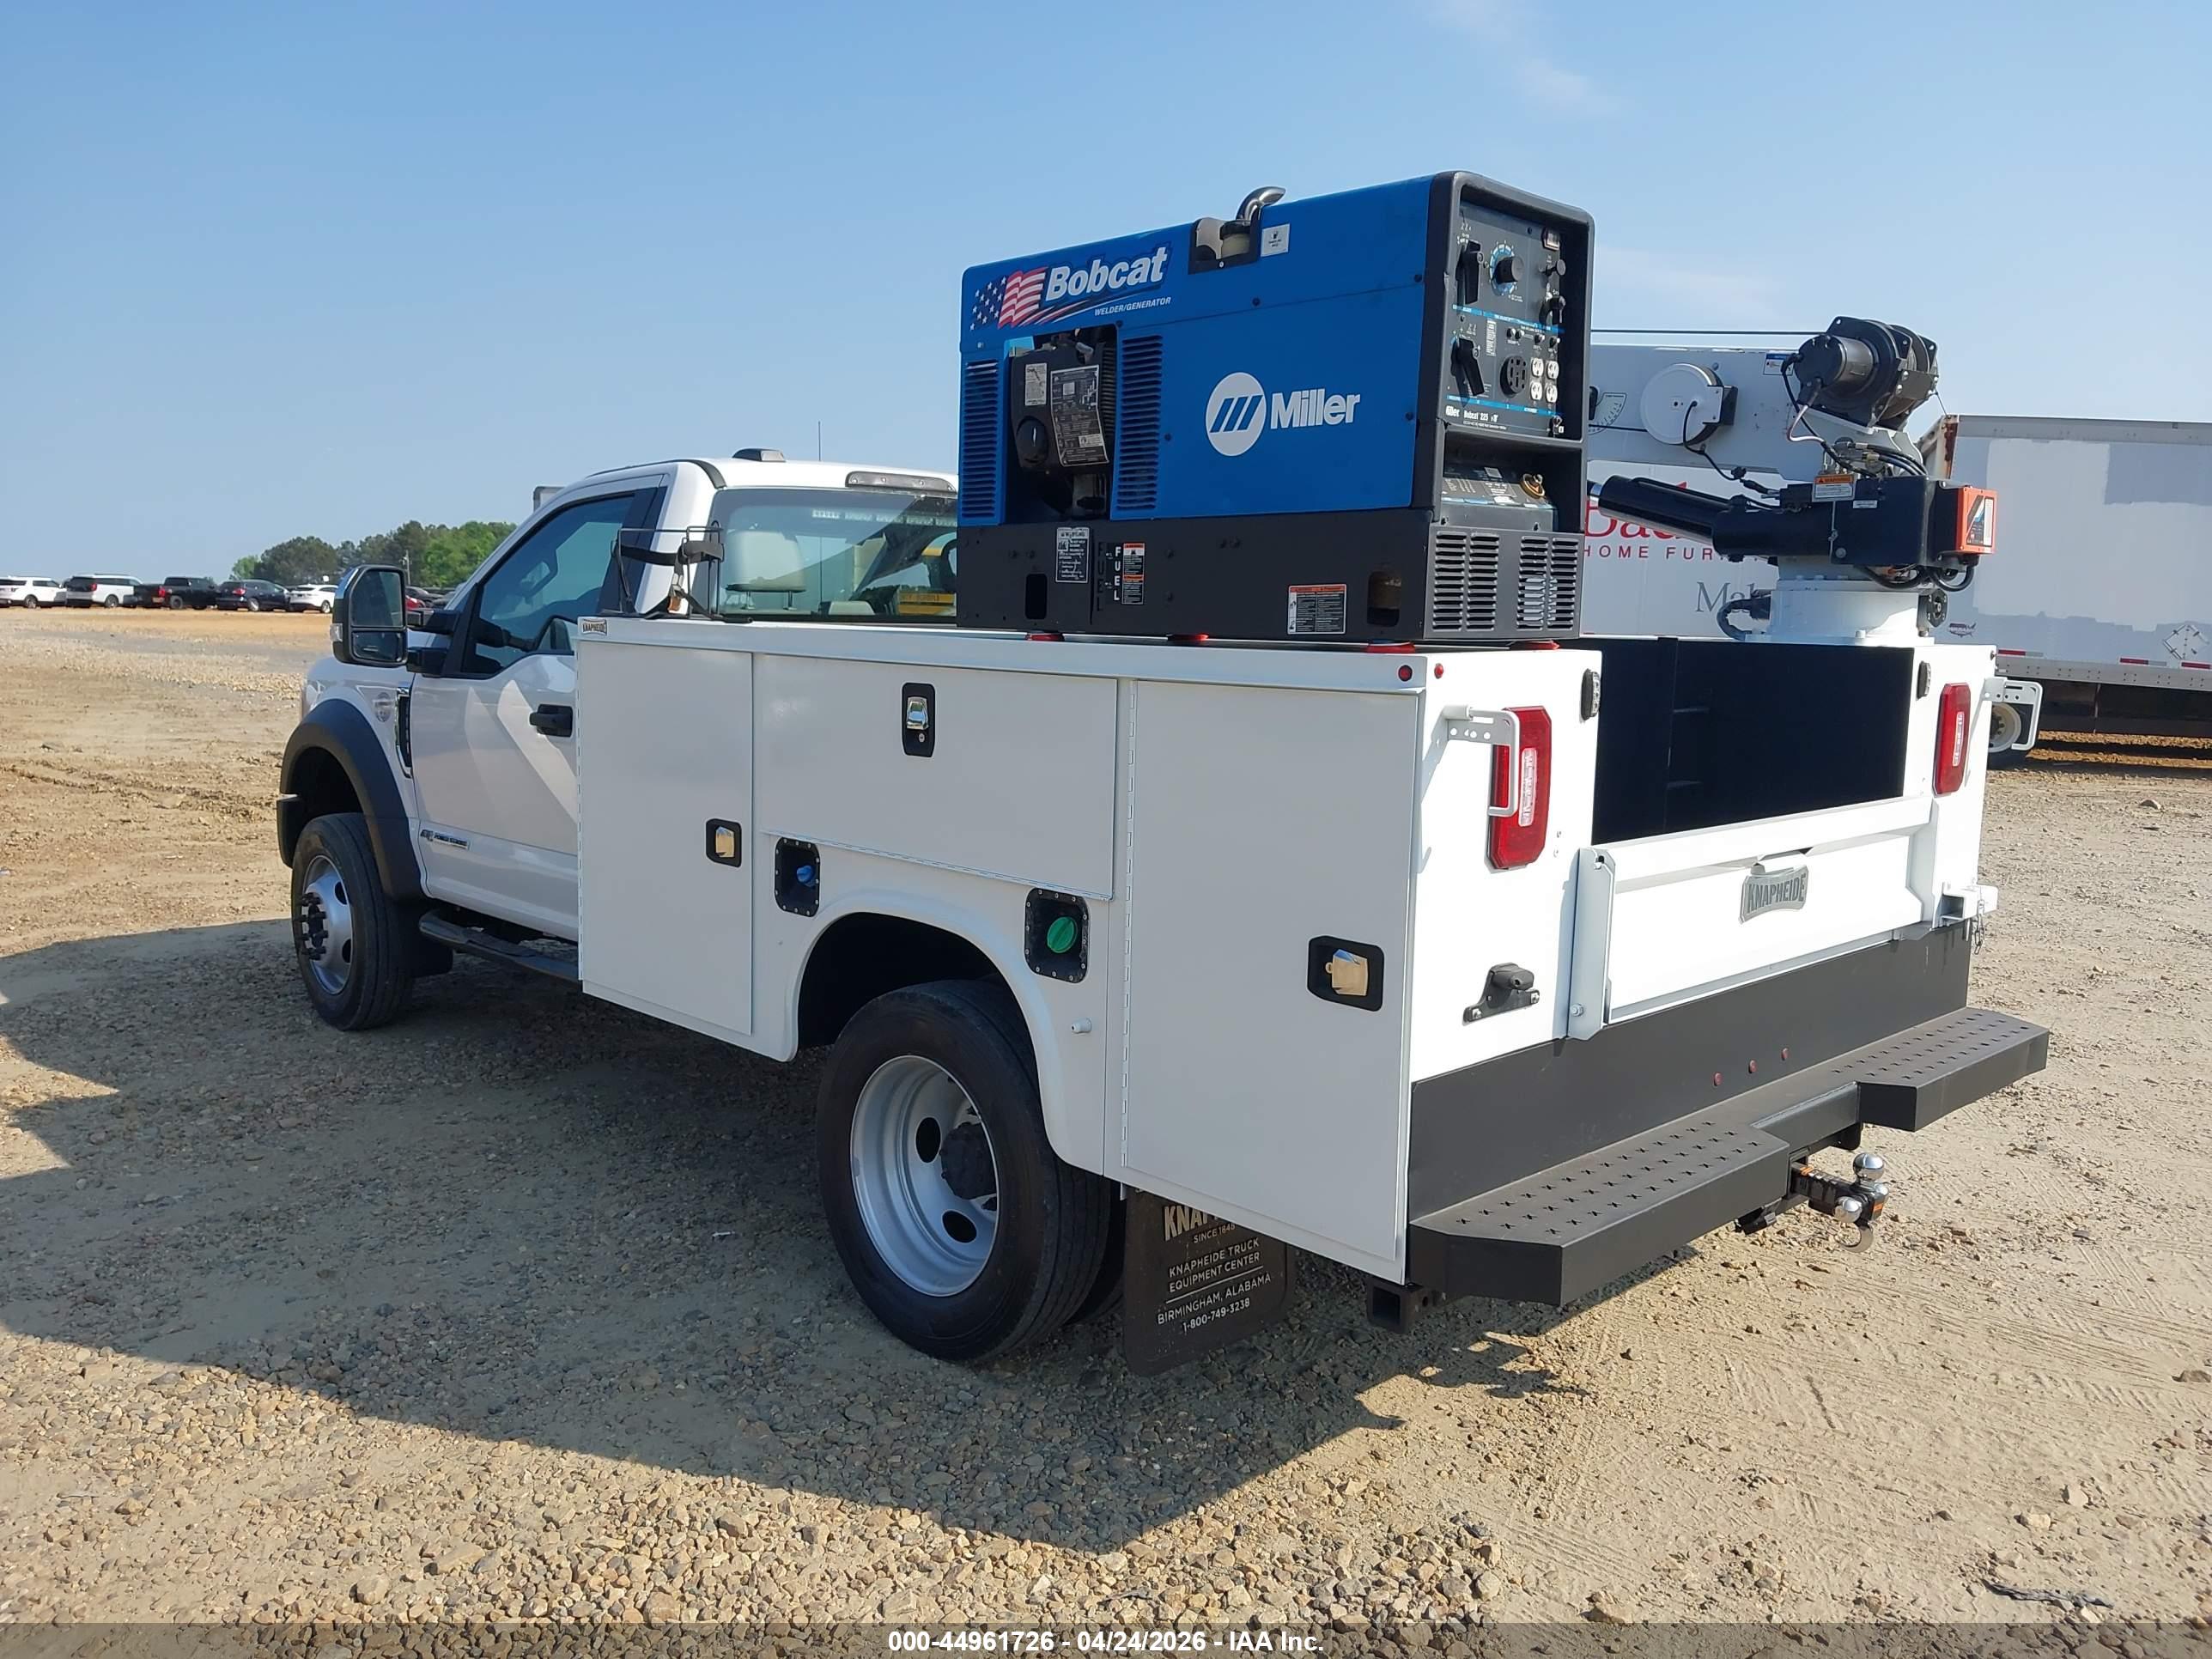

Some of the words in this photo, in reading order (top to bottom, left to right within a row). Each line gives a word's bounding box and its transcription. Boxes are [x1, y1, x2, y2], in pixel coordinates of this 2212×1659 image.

[1045, 246, 1168, 301] Bobcat
[1094, 296, 1171, 317] WELDER/GENERATOR
[1270, 388, 1361, 429] Miller
[1747, 872, 1807, 915] KNAPHEIDE
[1194, 1229, 1218, 1244] SINCE
[1169, 1249, 1225, 1279] KNAPHEIDE
[1228, 1237, 1260, 1256] TRUCK
[1169, 1264, 1223, 1293] EQUIPMENT
[1224, 1252, 1261, 1272] CENTER
[1158, 1291, 1224, 1325] BIRMINGHAM,
[1224, 1273, 1271, 1299] ALABAMA
[1182, 1297, 1250, 1332] 1-800-749-3238
